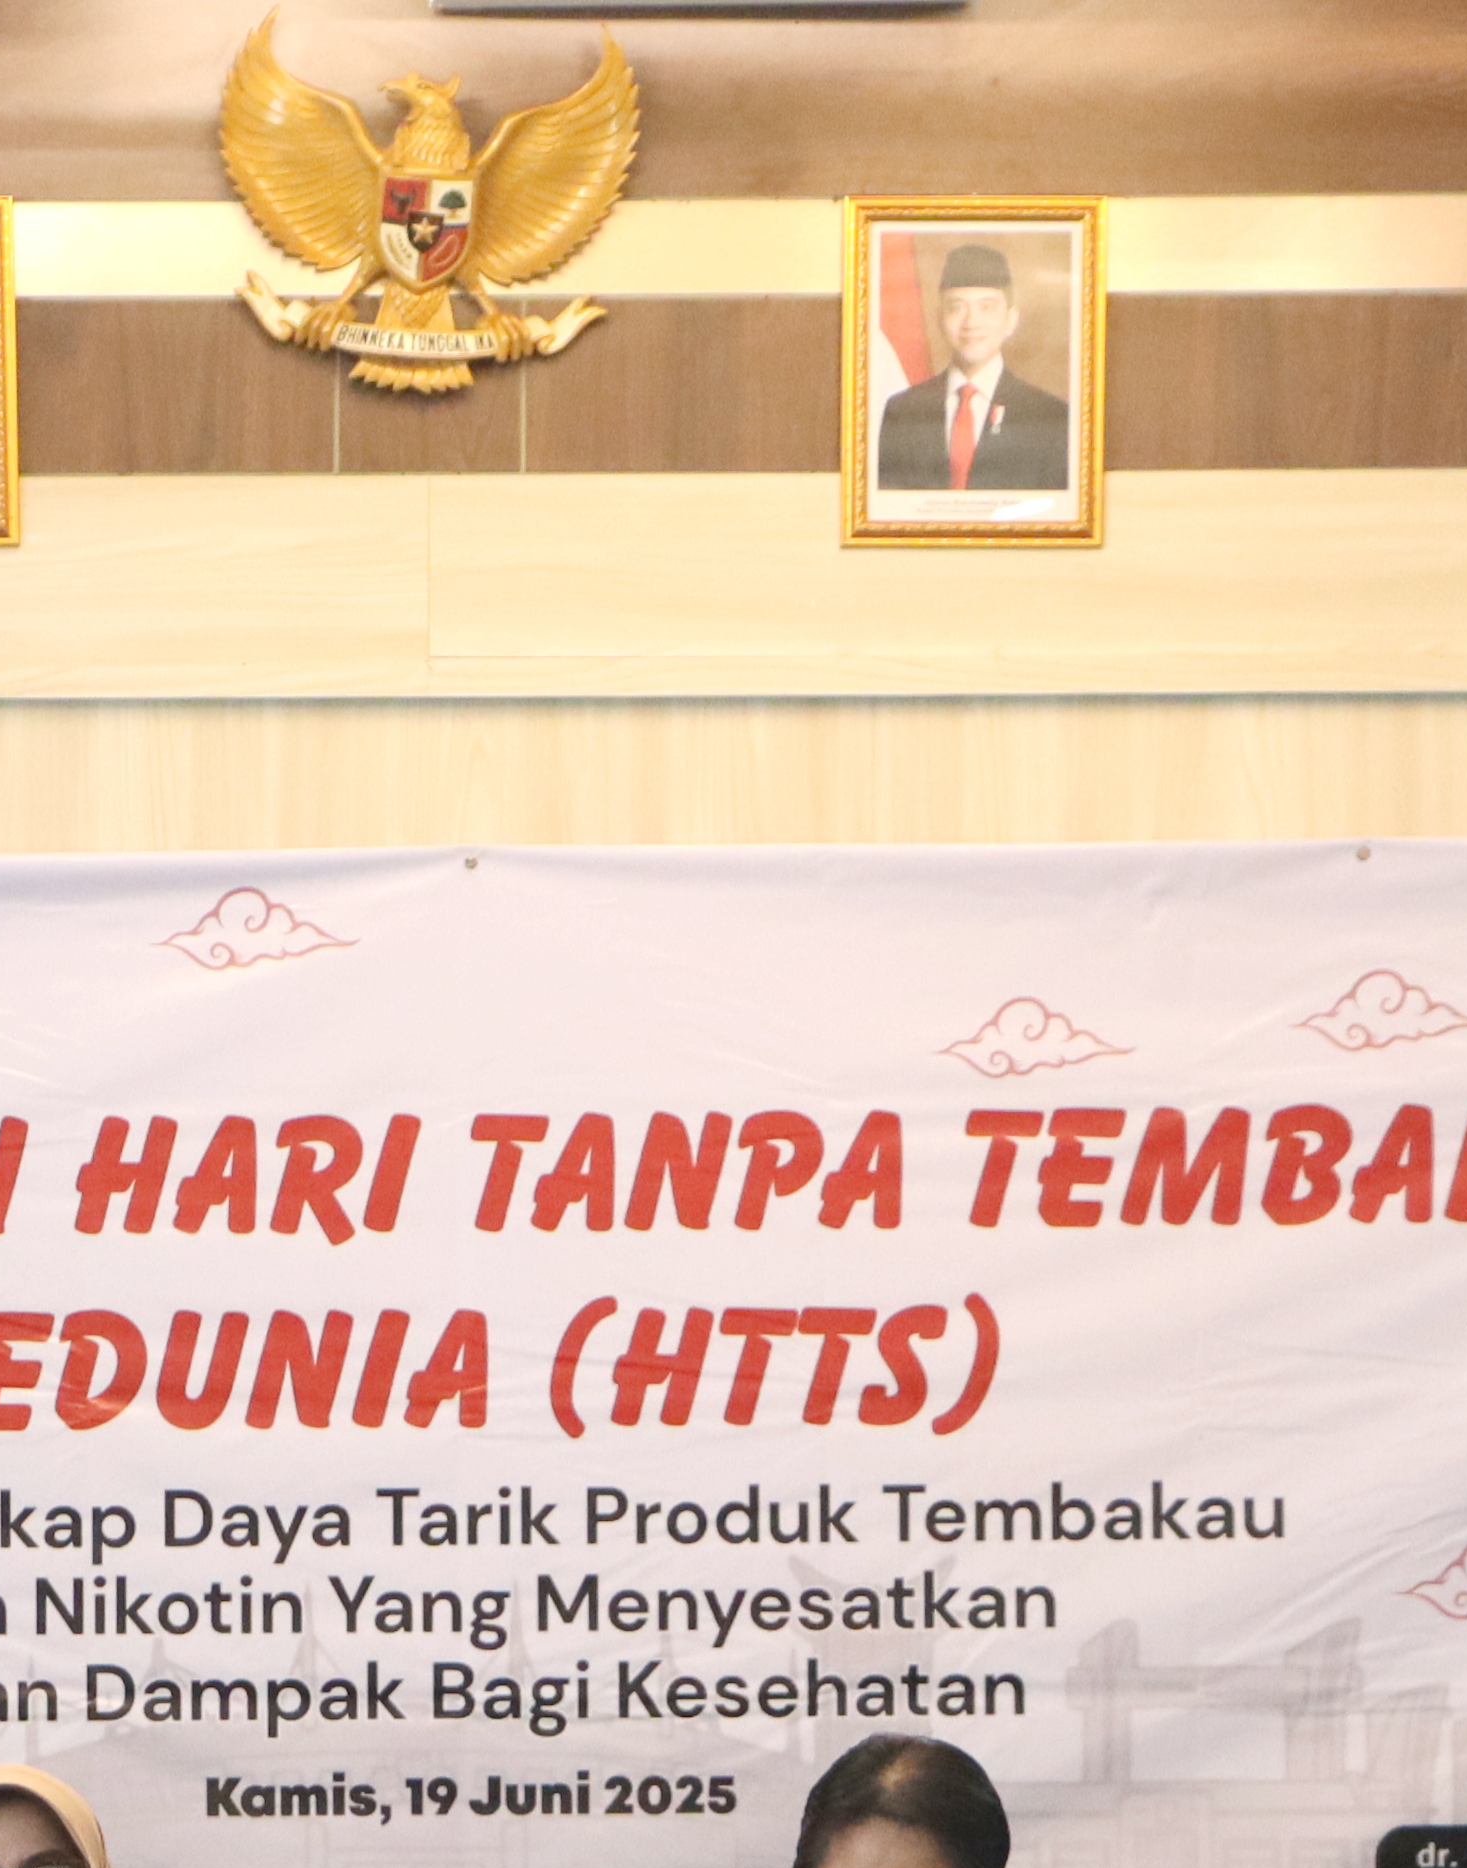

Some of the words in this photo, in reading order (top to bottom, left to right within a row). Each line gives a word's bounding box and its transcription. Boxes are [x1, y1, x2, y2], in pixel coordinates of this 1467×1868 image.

[411, 332, 470, 352] TUNGGAL
[74, 1112, 422, 1247] HARI
[470, 1109, 903, 1233] TANPA
[549, 1291, 1002, 1440] (HTTS)
[164, 1489, 352, 1564] Daya
[376, 1486, 560, 1548] Tarik
[586, 1483, 858, 1546] Produk
[881, 1480, 1286, 1543] Tembakau
[34, 1575, 304, 1637] Nikotin
[327, 1574, 511, 1648] Yang
[536, 1571, 1058, 1648] Menyesatkan
[86, 1661, 406, 1738] Dampak
[432, 1660, 591, 1738] Bagi
[617, 1658, 1027, 1720] Kesehatan
[205, 1773, 393, 1825] Kamis,
[406, 1777, 458, 1816] 19
[467, 1771, 592, 1816] Juni
[604, 1775, 737, 1816] 2025
